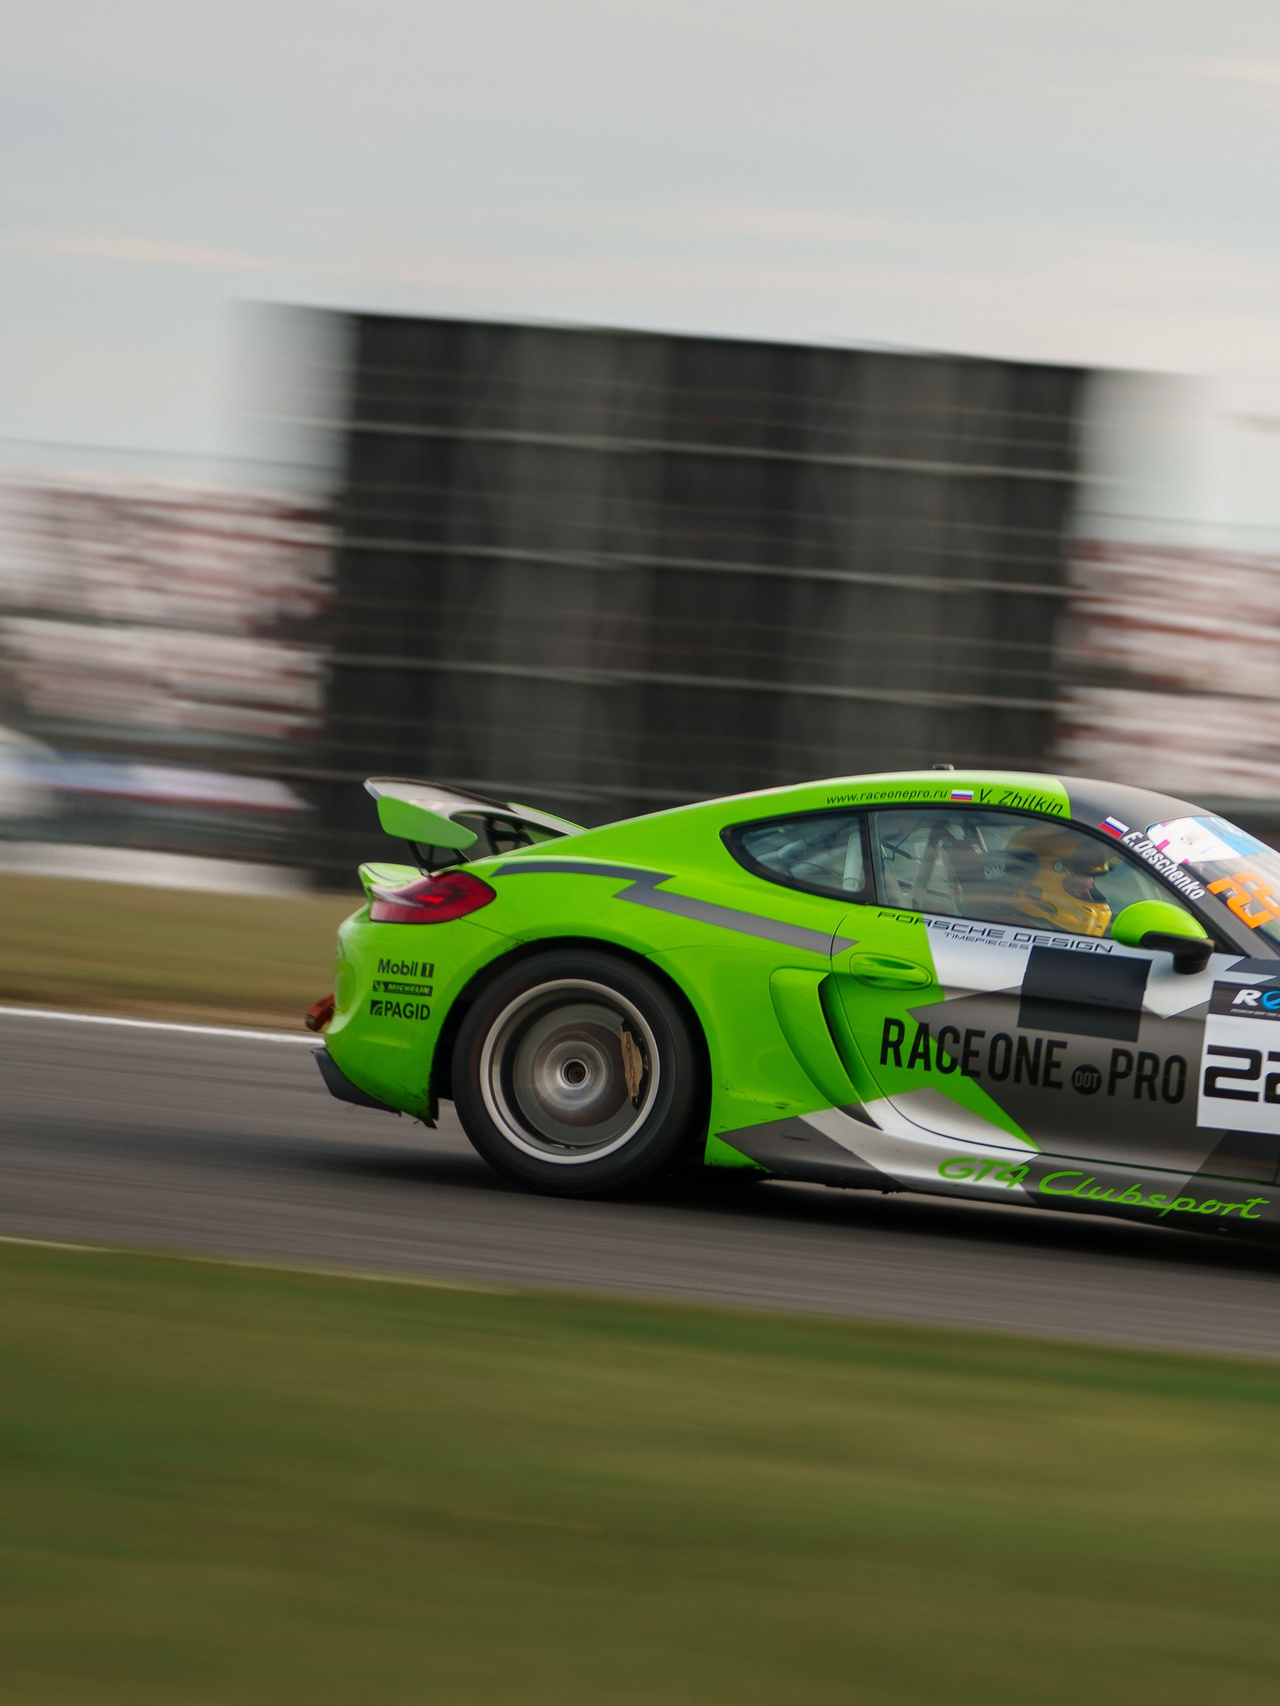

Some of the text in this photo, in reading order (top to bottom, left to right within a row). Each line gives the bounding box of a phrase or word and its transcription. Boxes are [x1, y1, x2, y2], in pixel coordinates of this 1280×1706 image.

[827, 789, 948, 805] www.raceonepro.ru
[980, 788, 1064, 816] V. Zhilkin
[878, 911, 1114, 954] PORSCHE DESIGN
[944, 932, 1029, 950] TIMEPIECES
[377, 957, 435, 978] Mobil 1
[387, 983, 431, 995] MICHELIN
[384, 1000, 431, 1020] PAGID
[1073, 1069, 1100, 1089] DOT
[1106, 1047, 1188, 1104] PRO
[938, 1156, 1271, 1219] GT4 Clubsport
